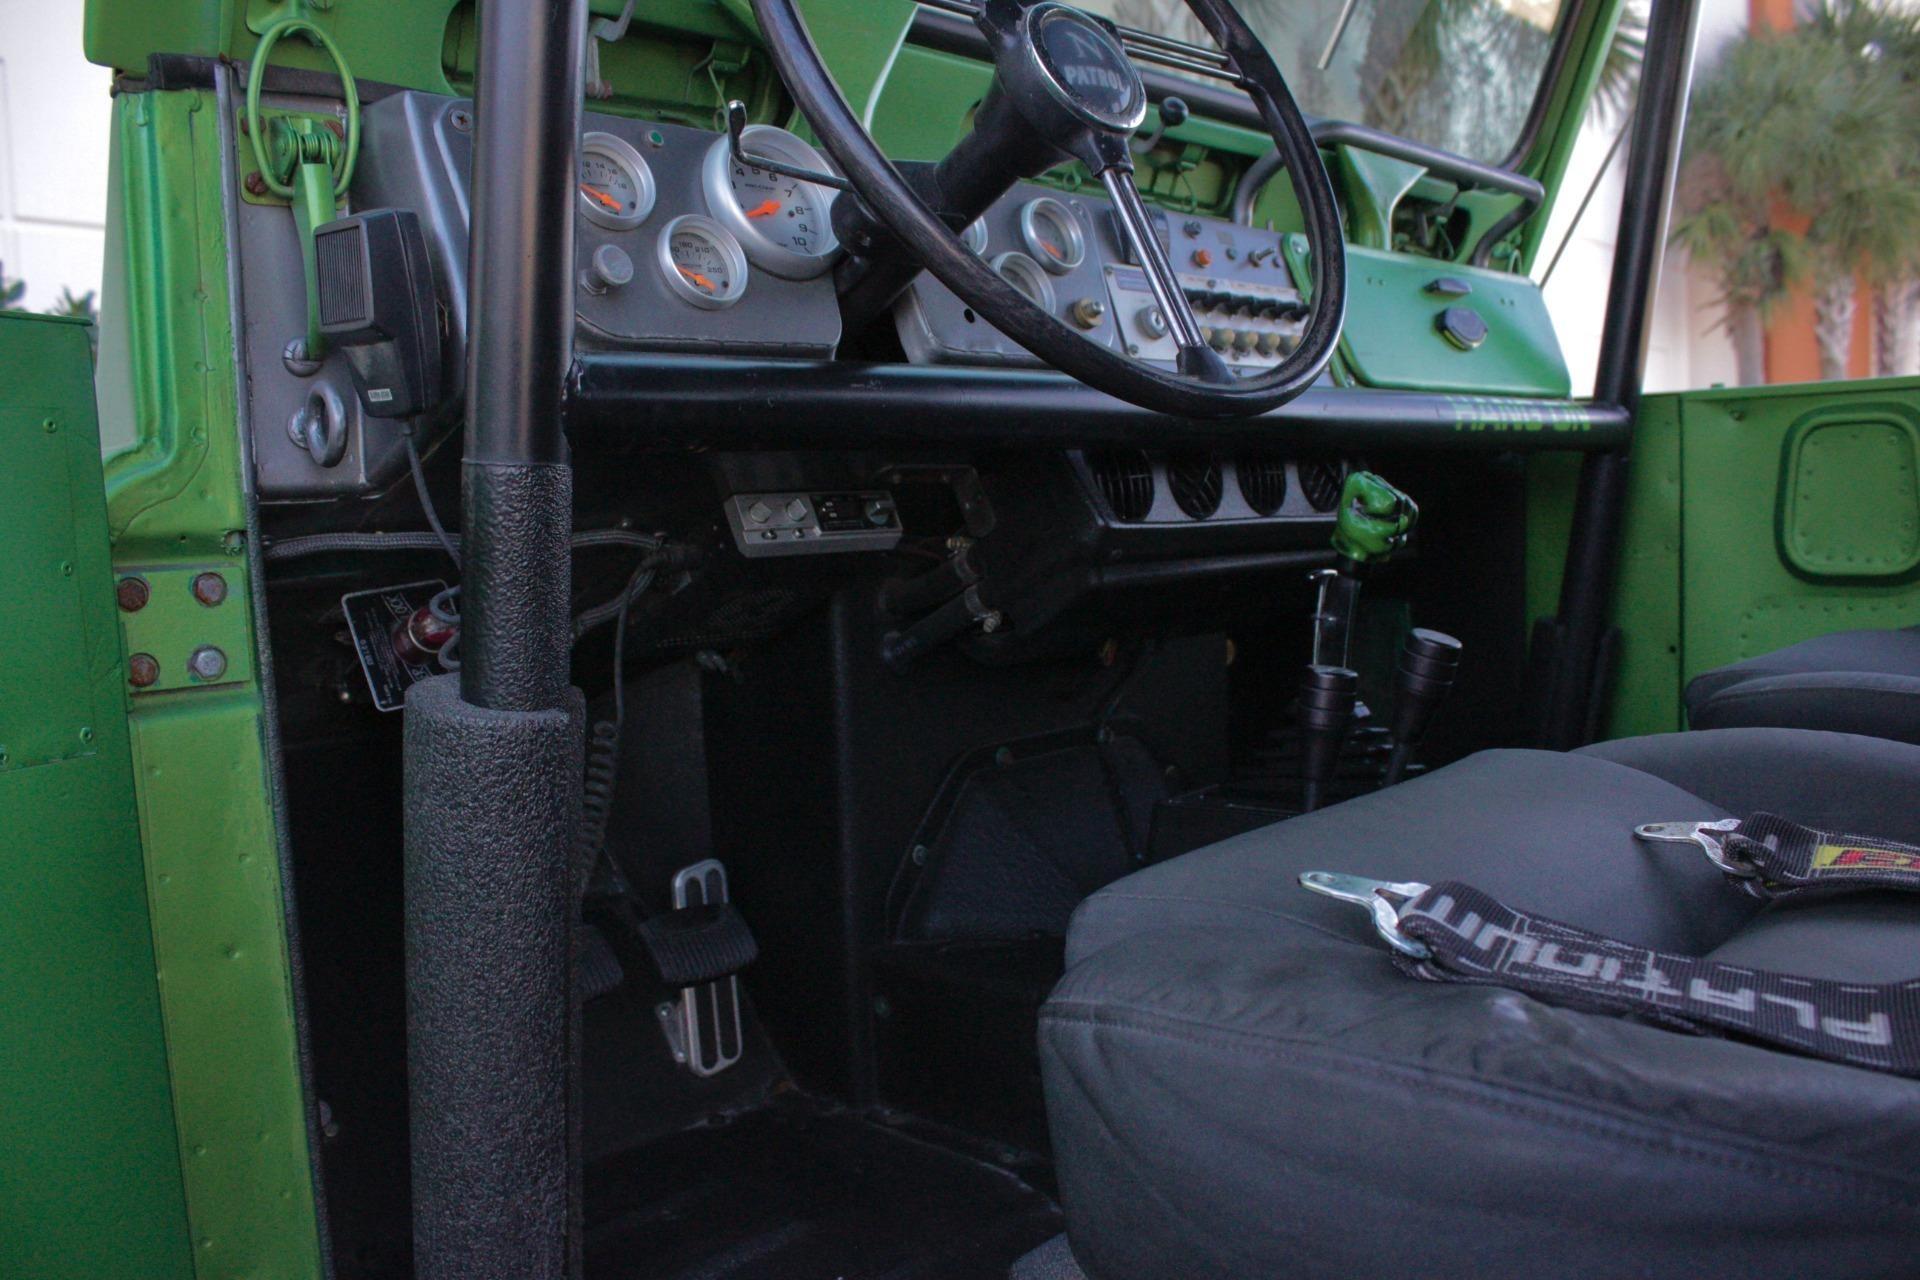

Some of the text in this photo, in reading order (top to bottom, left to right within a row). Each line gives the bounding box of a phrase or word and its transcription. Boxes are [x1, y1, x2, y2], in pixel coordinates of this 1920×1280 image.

[1063, 65, 1126, 93] PATROL
[736, 167, 745, 177] 4
[768, 172, 778, 182] 6
[784, 189, 792, 198] 7
[795, 206, 805, 215] 8
[798, 223, 808, 233] 9
[791, 236, 807, 246] 10
